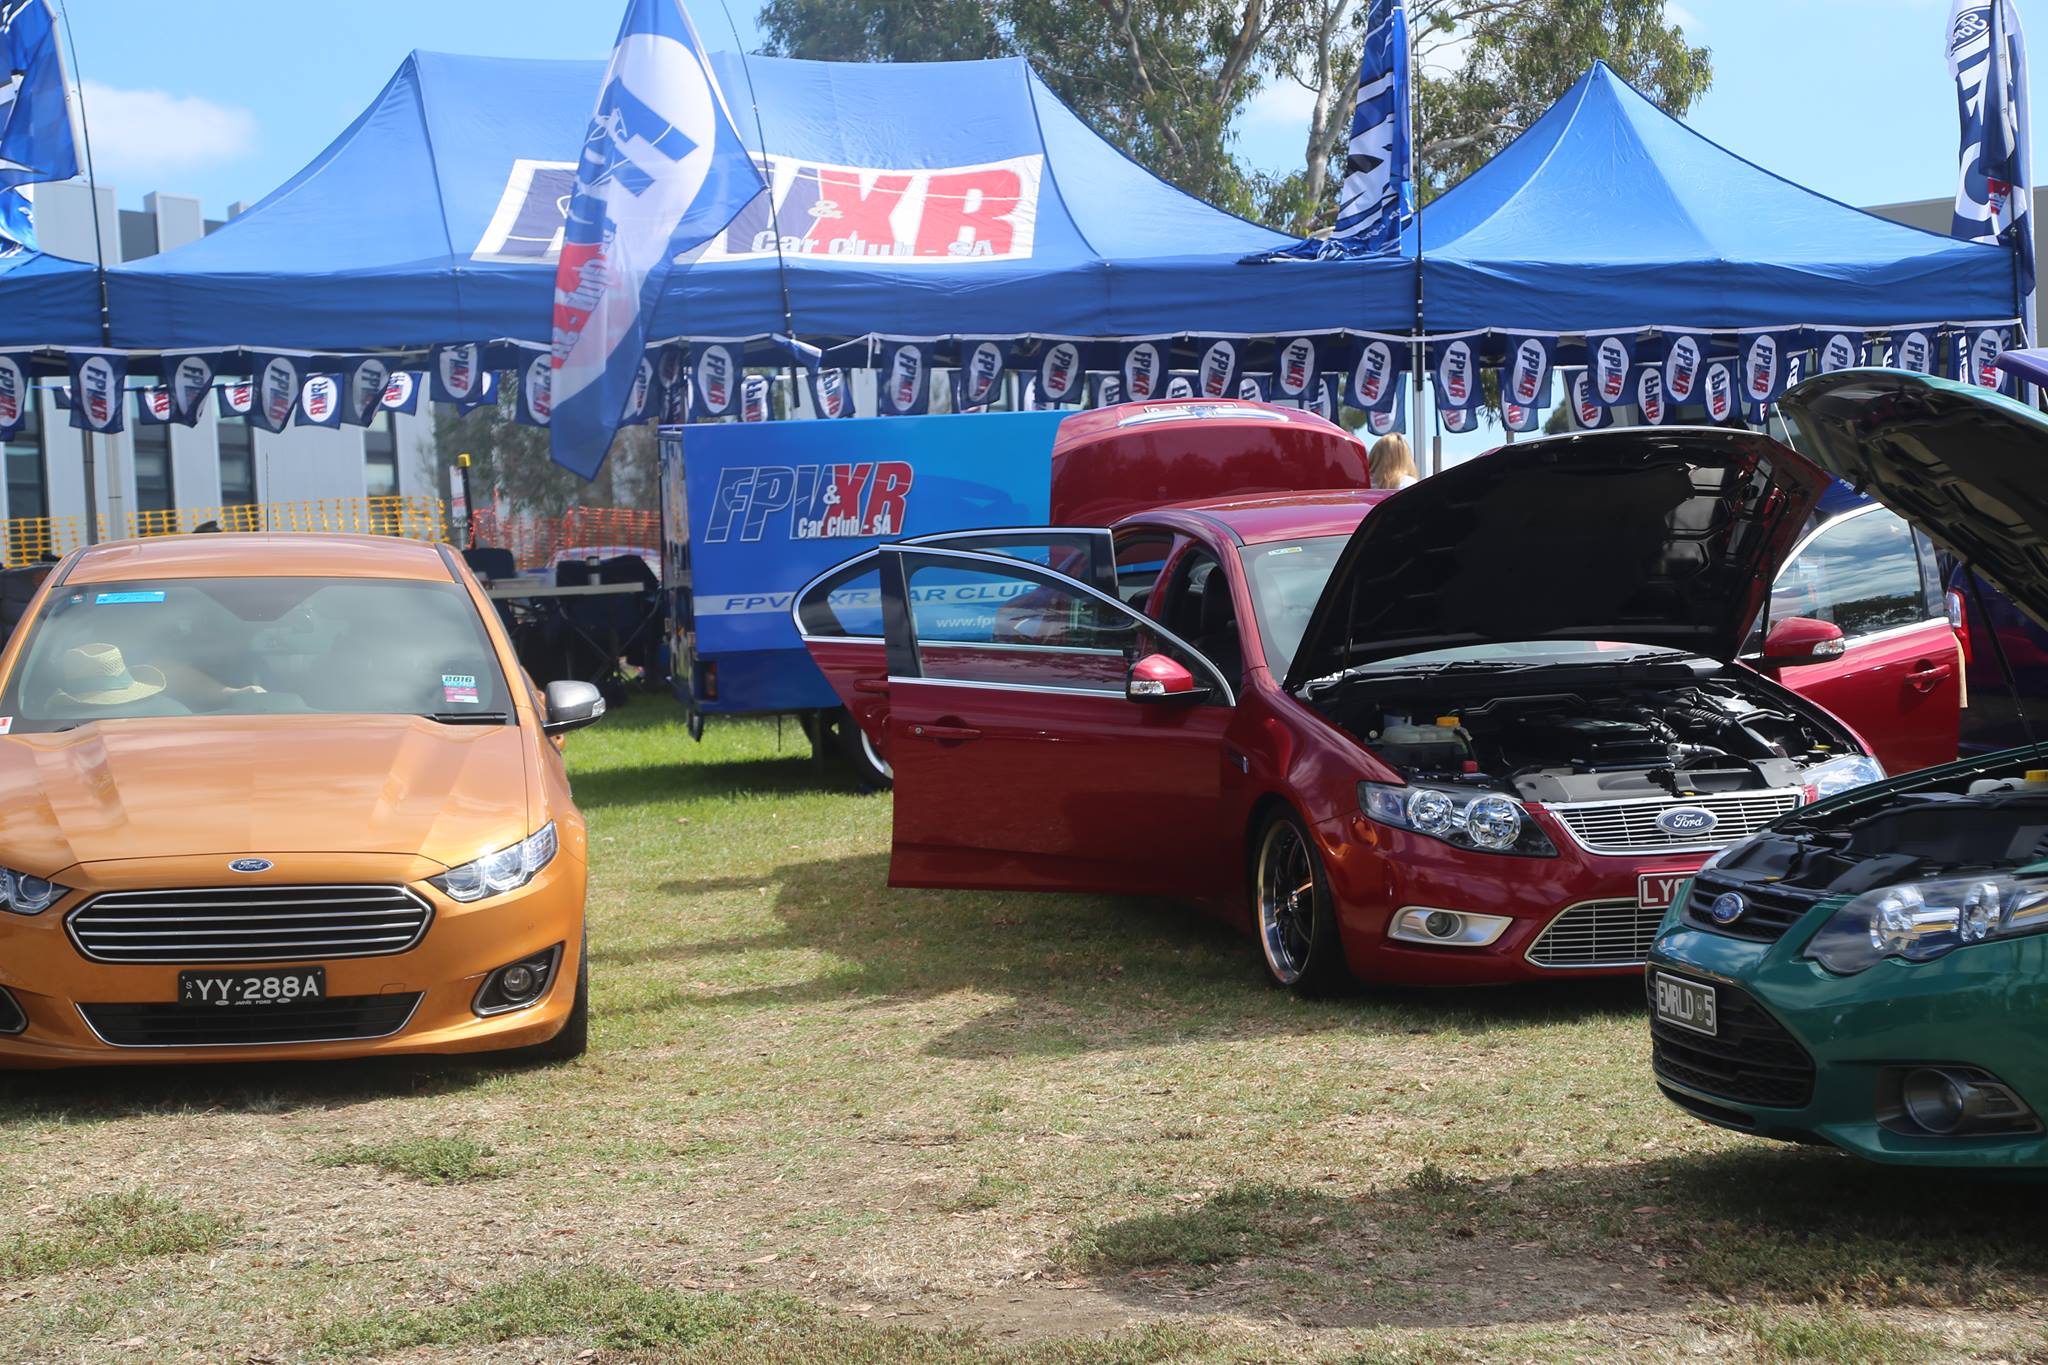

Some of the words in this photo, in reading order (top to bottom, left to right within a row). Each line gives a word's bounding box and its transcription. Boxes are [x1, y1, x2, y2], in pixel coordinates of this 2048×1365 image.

[828, 231, 915, 257] Club
[798, 517, 824, 539] Car
[827, 509, 859, 537] Club
[872, 514, 893, 536] SA
[724, 595, 791, 610] FPV
[910, 588, 946, 601] AR
[1673, 813, 1704, 828] Ford
